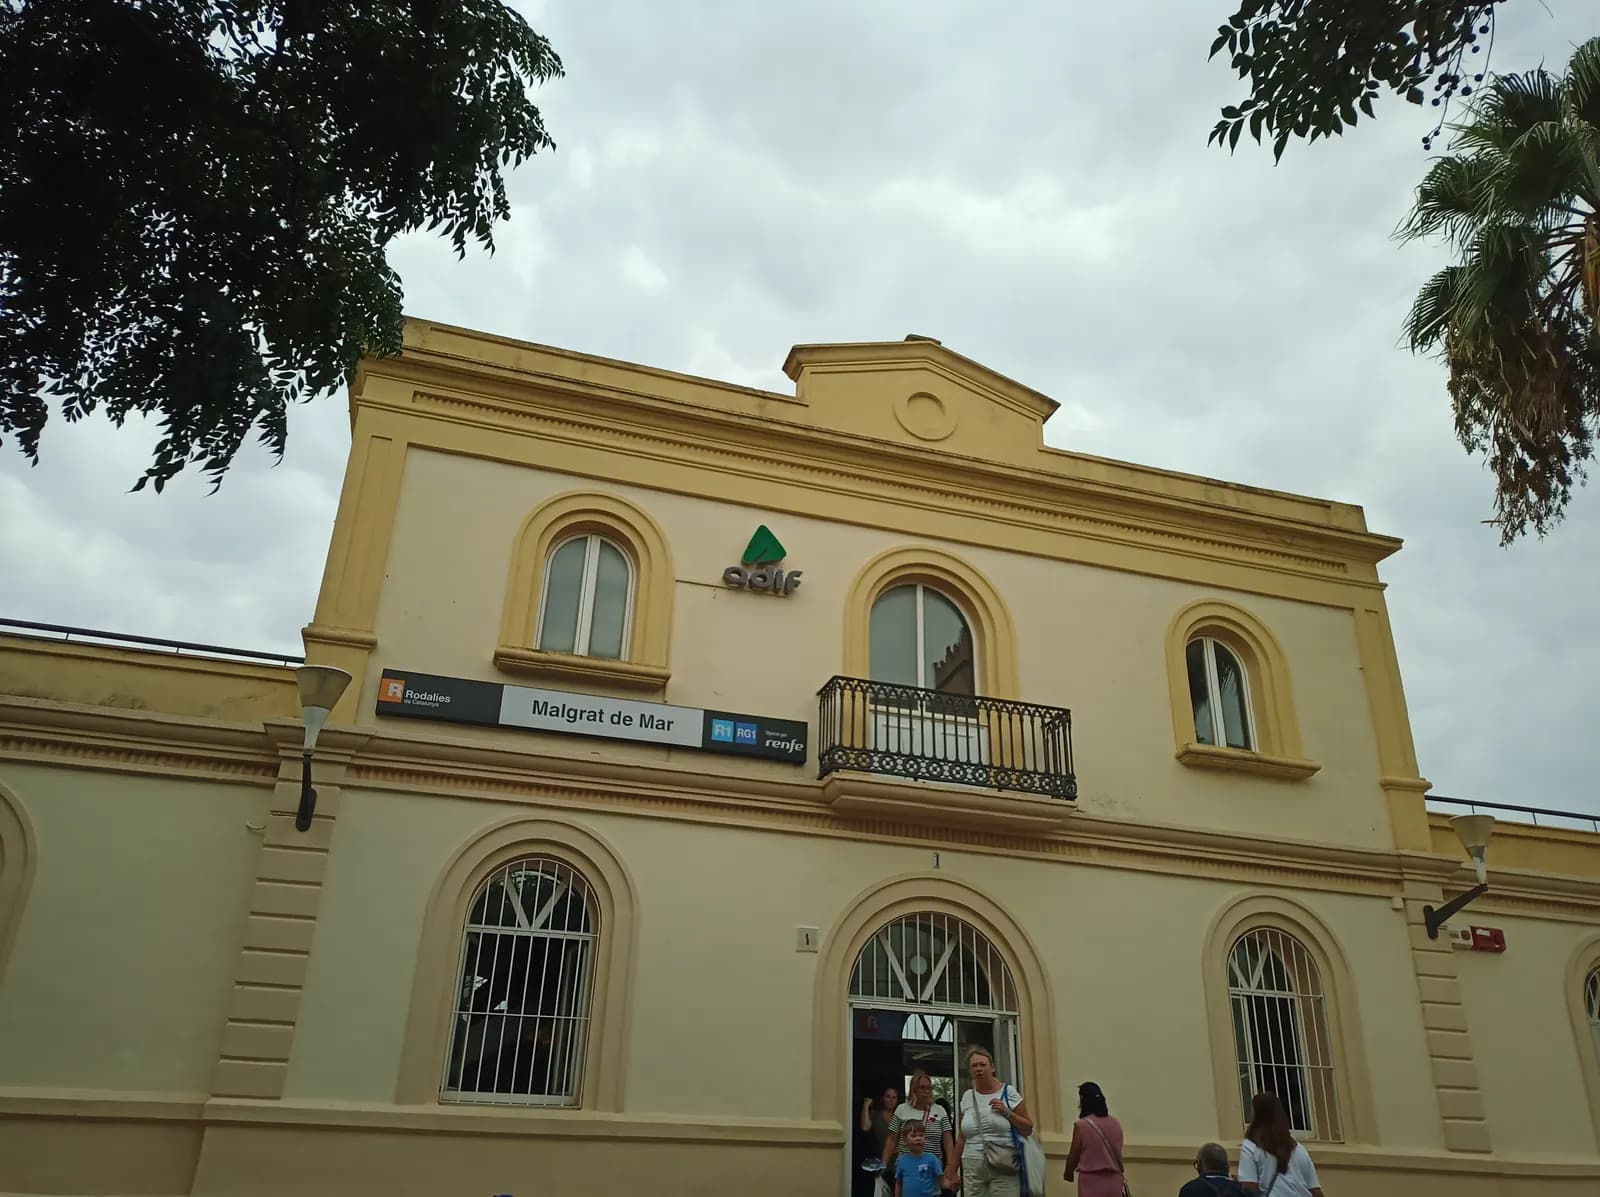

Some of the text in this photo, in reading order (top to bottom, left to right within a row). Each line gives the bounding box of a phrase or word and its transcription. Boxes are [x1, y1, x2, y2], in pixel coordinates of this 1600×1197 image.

[722, 566, 803, 595] adif
[388, 683, 451, 703] R Rodalies
[532, 700, 674, 731] Malgrat de Mar
[715, 724, 731, 737] R1
[737, 728, 756, 739] RG1
[765, 739, 804, 753] renfe
